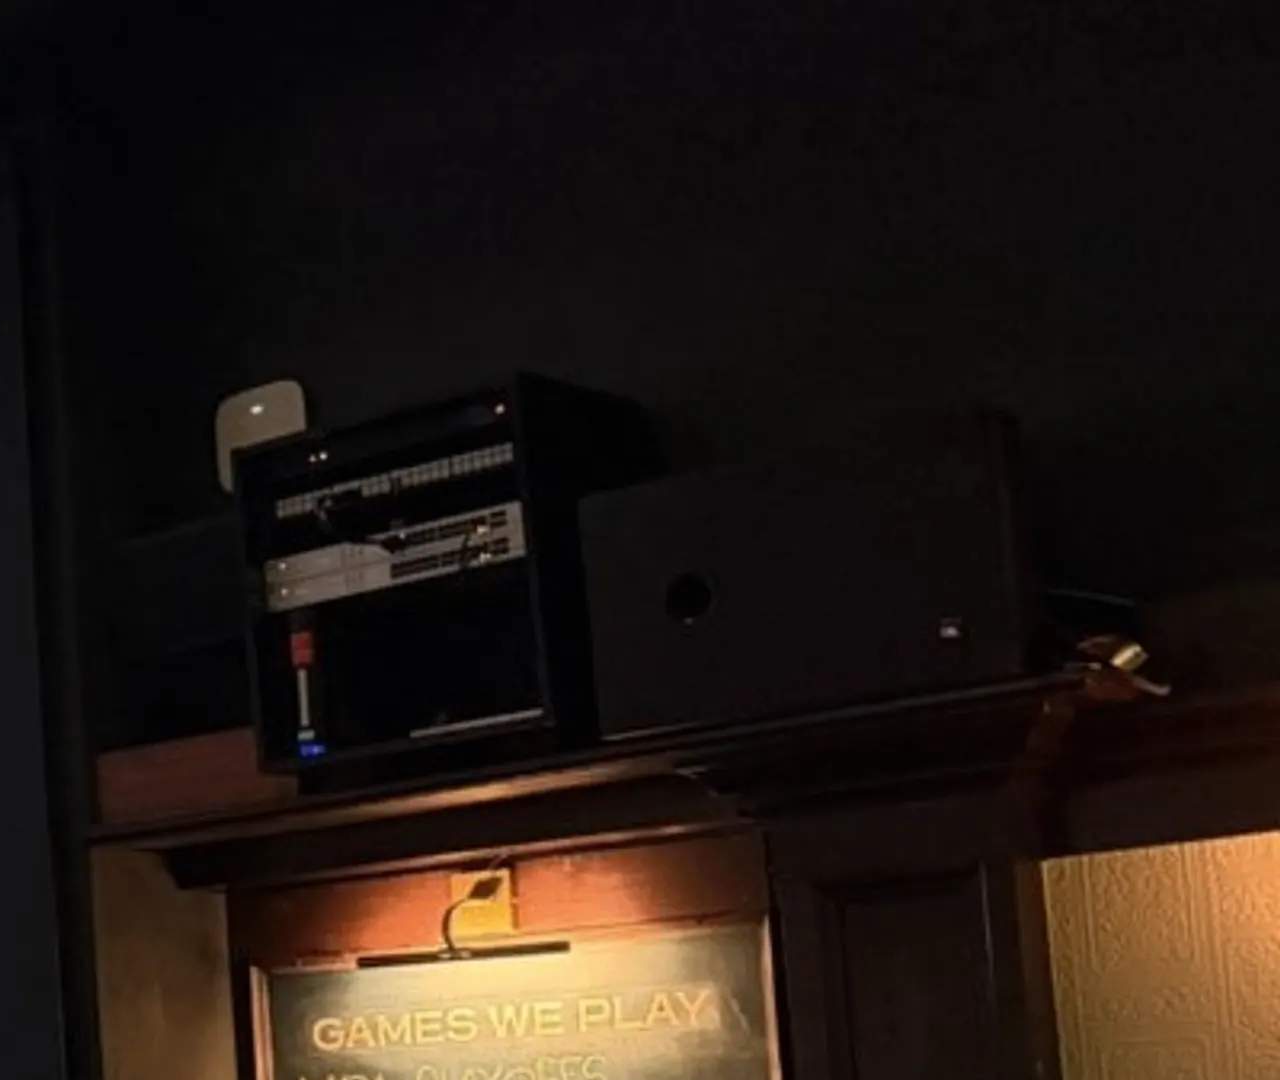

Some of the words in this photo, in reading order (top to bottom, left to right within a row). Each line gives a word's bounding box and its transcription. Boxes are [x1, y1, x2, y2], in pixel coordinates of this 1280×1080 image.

[312, 1008, 479, 1051] GAMES
[488, 1001, 565, 1039] WE
[577, 990, 714, 1032] PLAY
